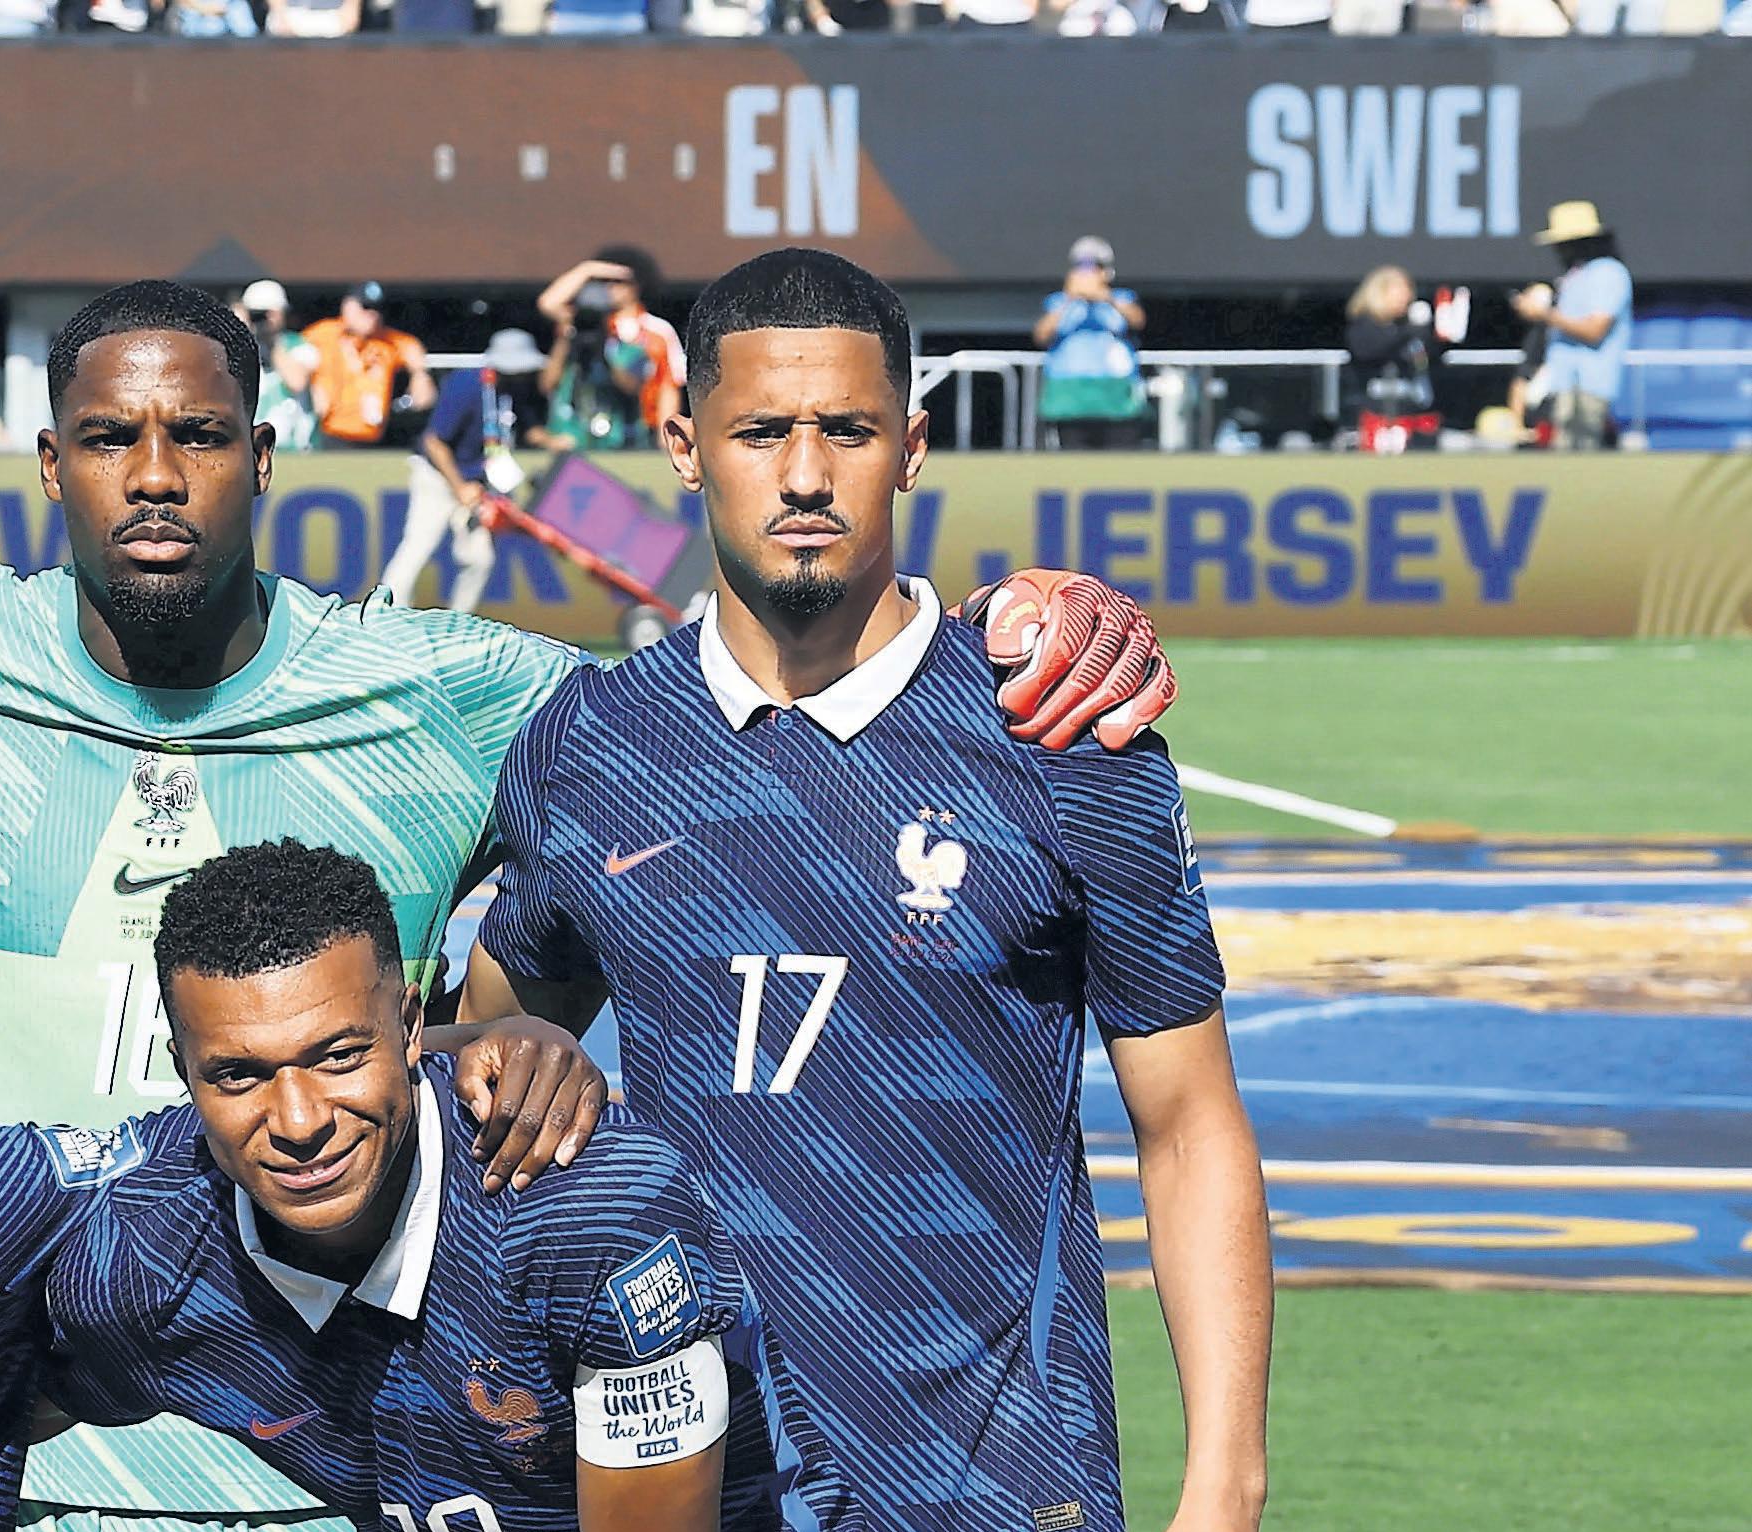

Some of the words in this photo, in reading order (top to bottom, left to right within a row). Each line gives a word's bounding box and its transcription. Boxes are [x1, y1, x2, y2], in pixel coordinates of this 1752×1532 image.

[724, 85, 861, 238] EN
[975, 487, 1549, 606] JERSEY
[728, 955, 849, 1096] 17
[622, 1253, 678, 1299] FOOTBALL
[629, 1267, 684, 1318] UNITES
[634, 1312, 661, 1336] the
[659, 1282, 692, 1325] World
[658, 1315, 682, 1337] FIFA
[603, 1360, 692, 1393] FOOTBALL
[604, 1379, 696, 1417] UNITES
[603, 1420, 642, 1440] the
[642, 1400, 706, 1438] World
[637, 1438, 679, 1458] FIFA
